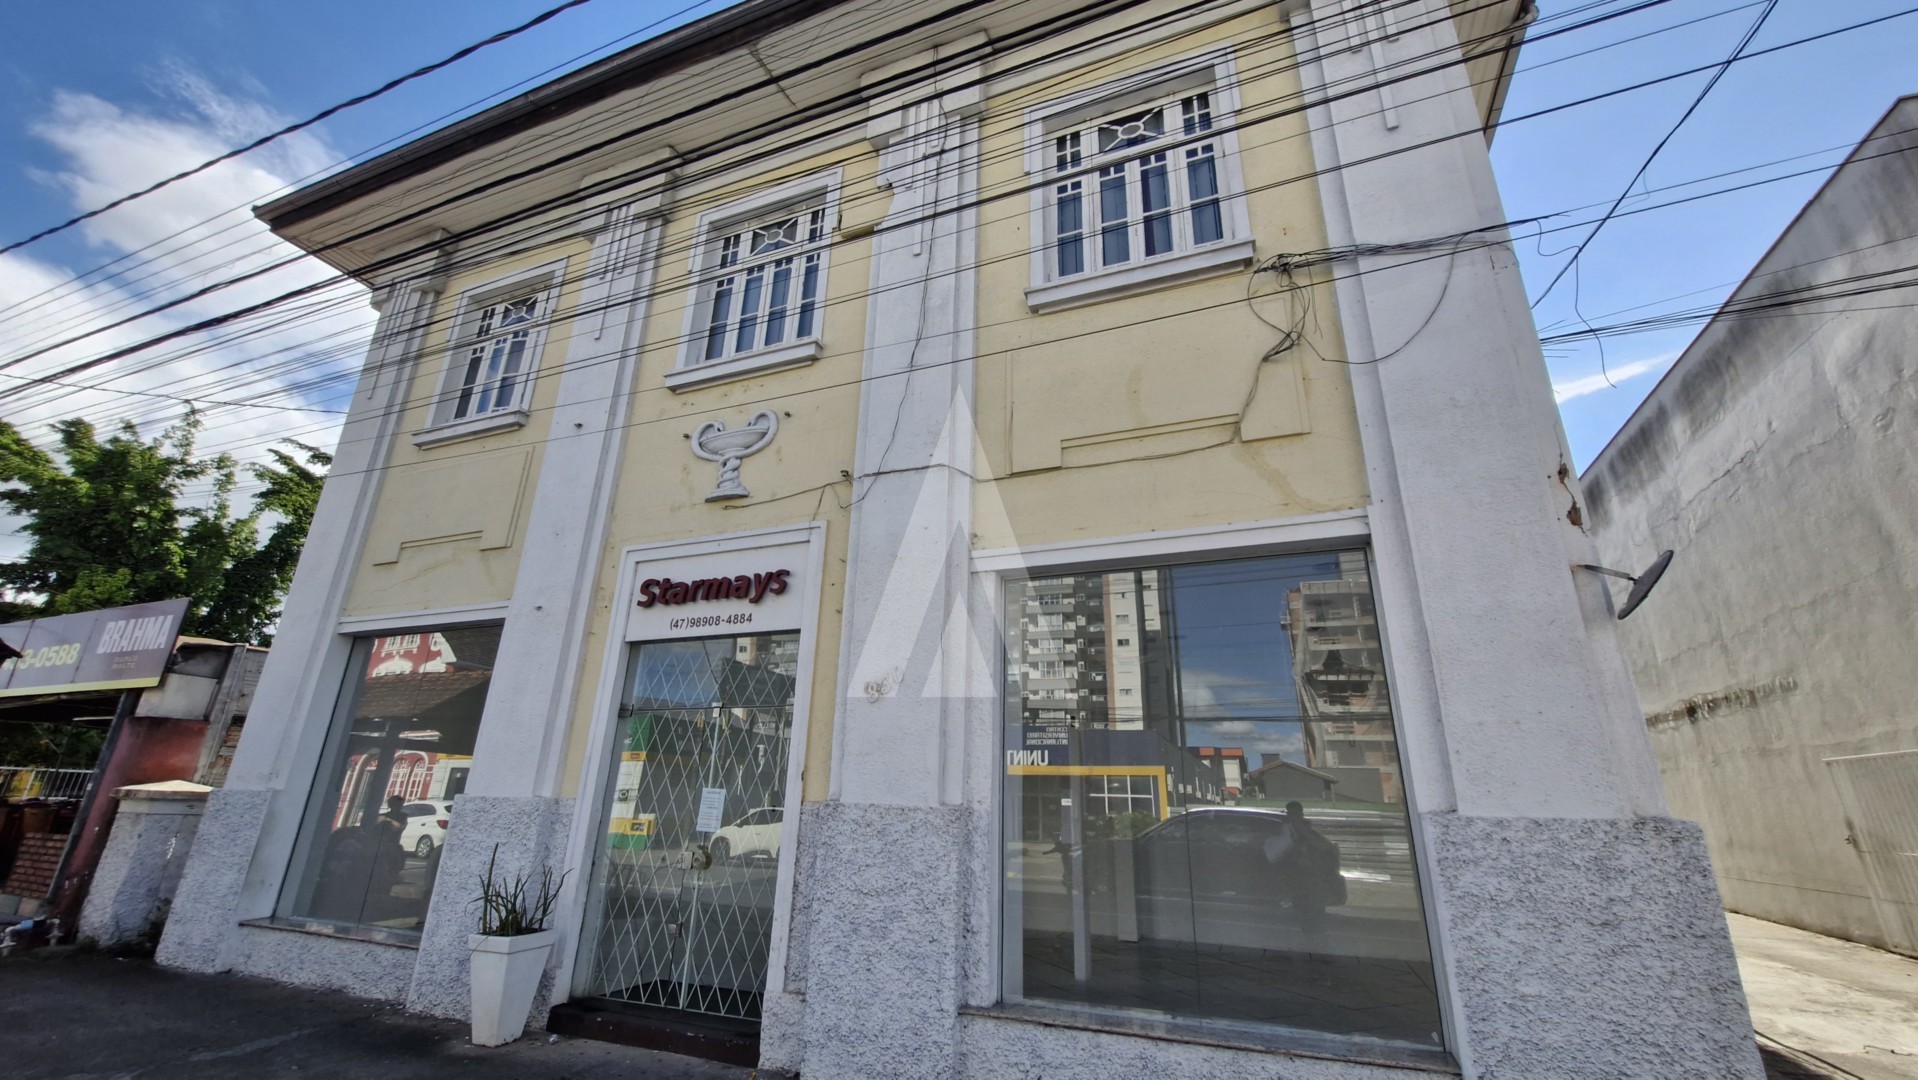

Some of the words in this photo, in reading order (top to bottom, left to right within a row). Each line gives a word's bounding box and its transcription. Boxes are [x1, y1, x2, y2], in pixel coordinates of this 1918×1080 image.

[637, 569, 790, 608] Starmays
[97, 615, 174, 654] BRAHMA
[670, 613, 752, 630] (47)98908-4884
